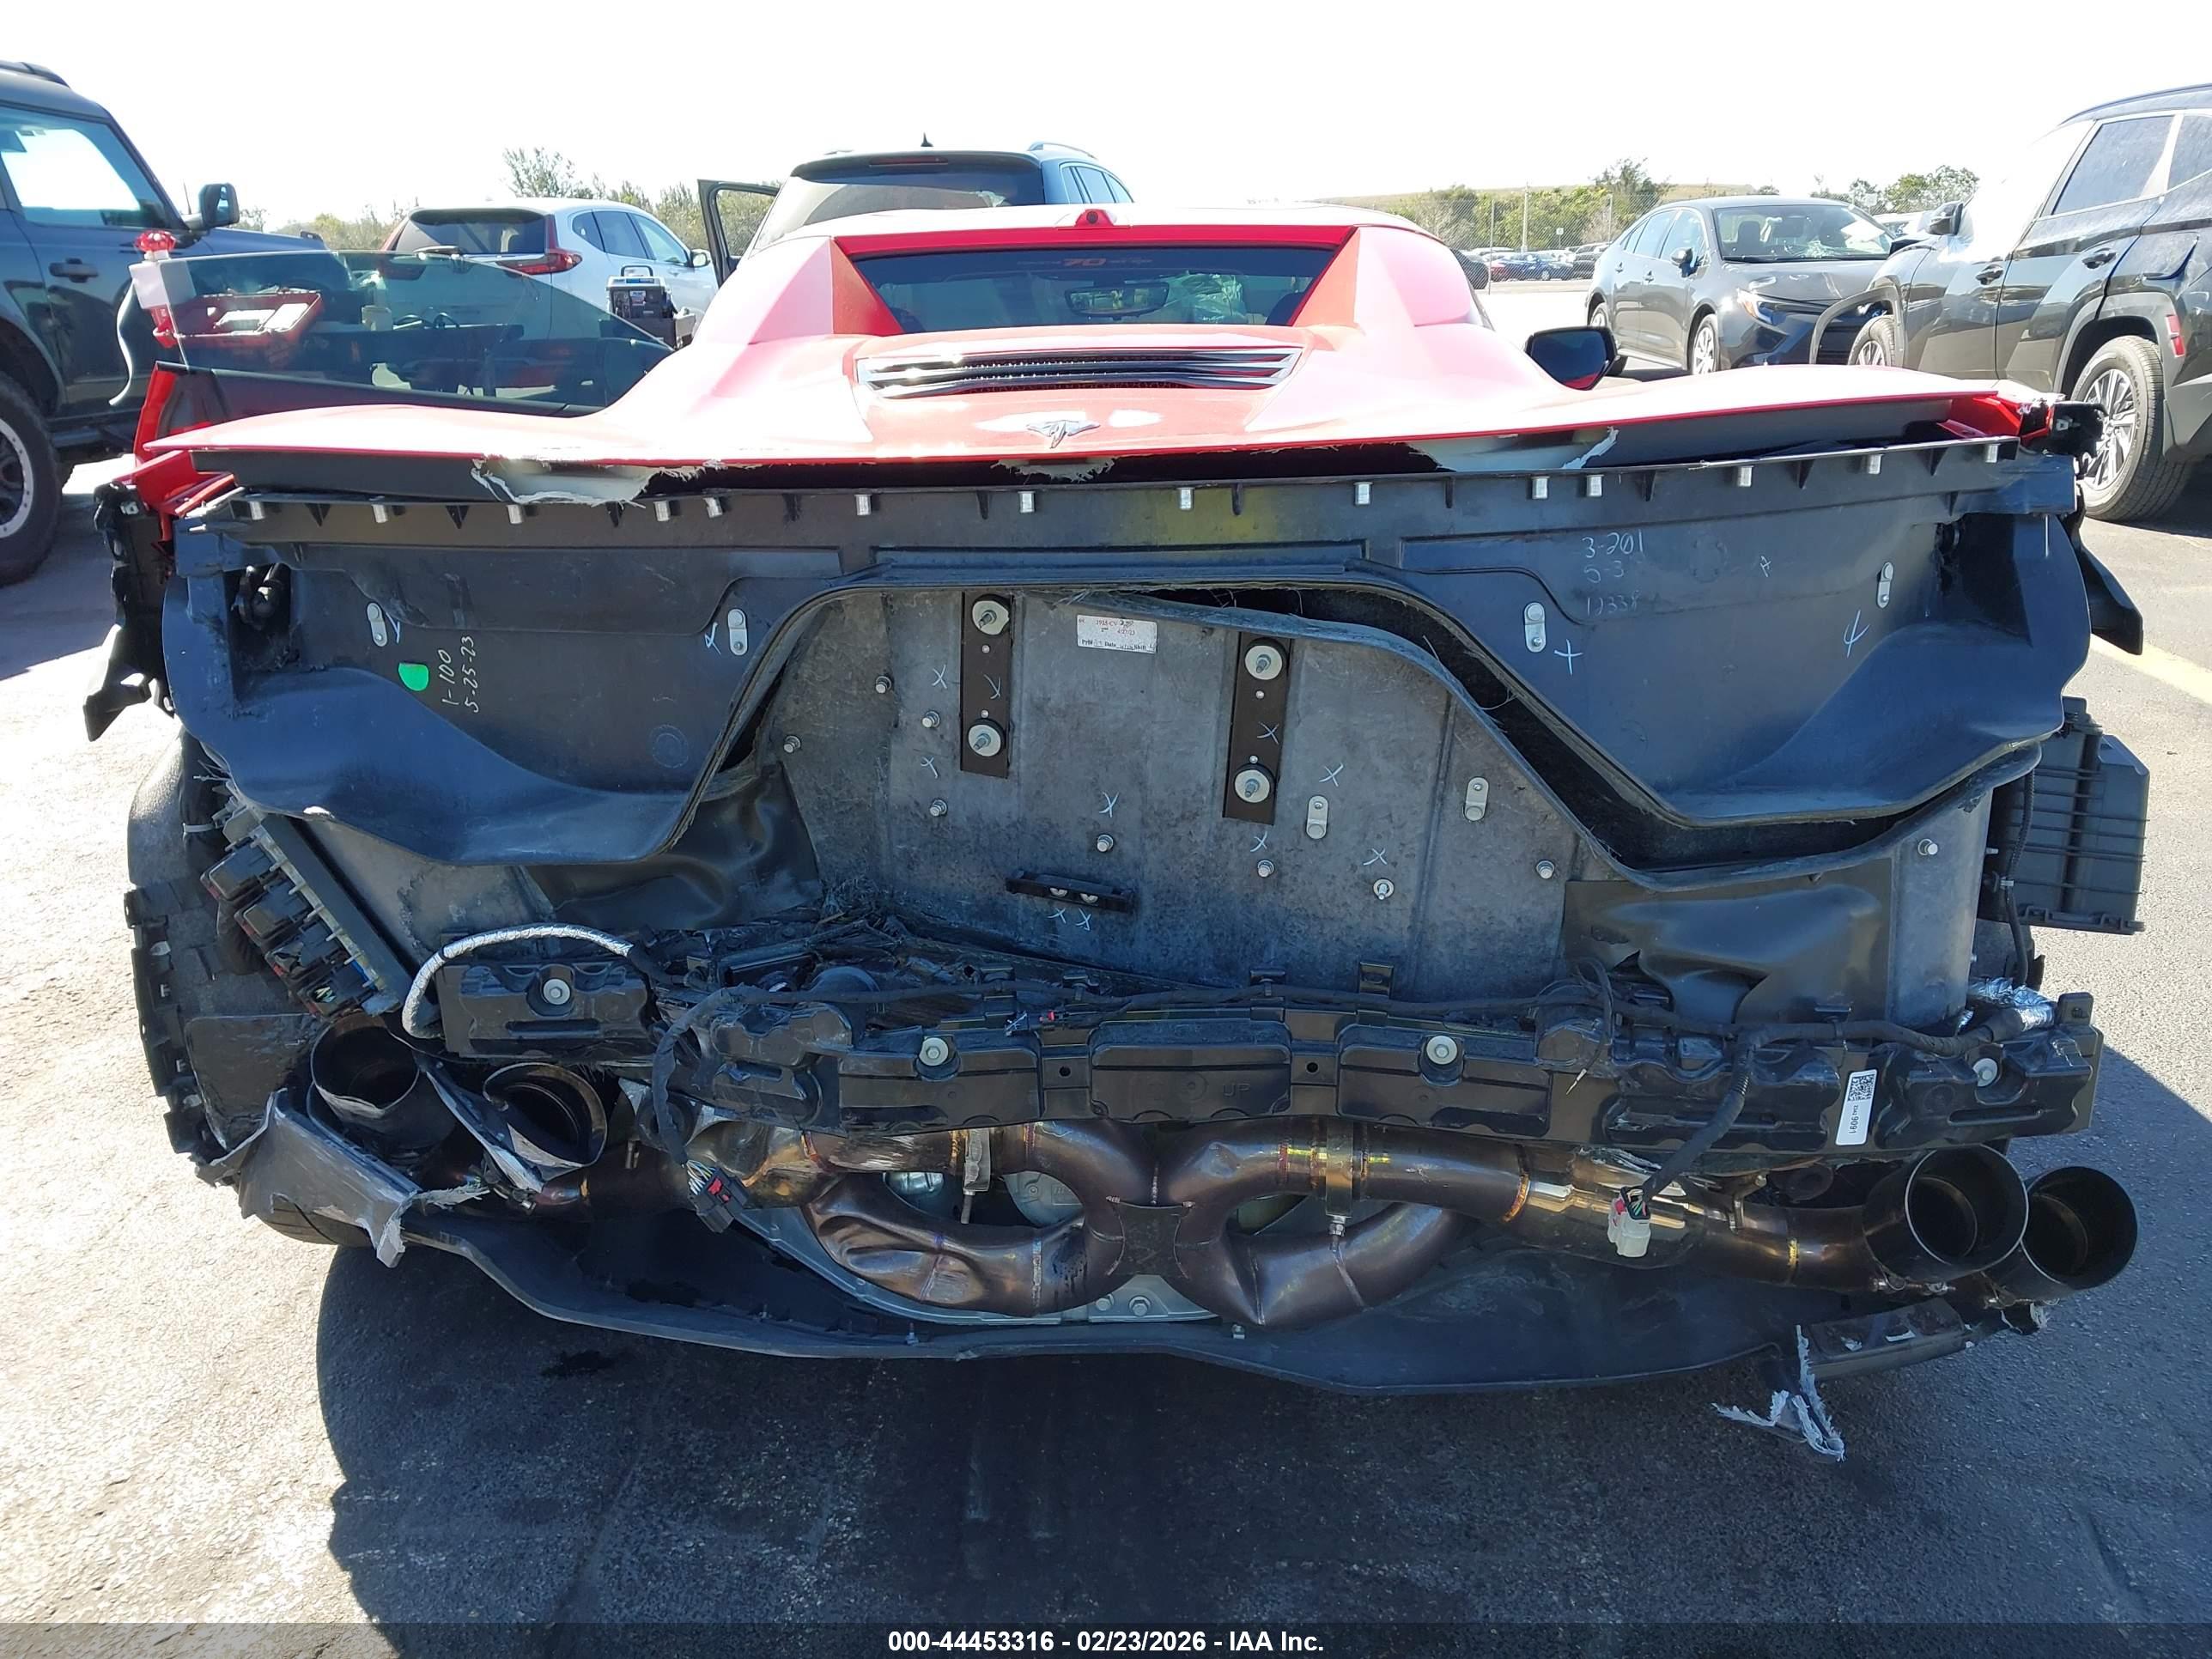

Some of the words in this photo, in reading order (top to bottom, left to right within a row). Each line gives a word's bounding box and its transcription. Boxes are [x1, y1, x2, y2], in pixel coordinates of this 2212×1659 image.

[1582, 529, 1644, 558] 3-201
[438, 649, 459, 705] 1-100
[460, 635, 479, 713] 5-25-23
[1223, 1082, 1250, 1097] UP
[1849, 1115, 1859, 1134] 9091
